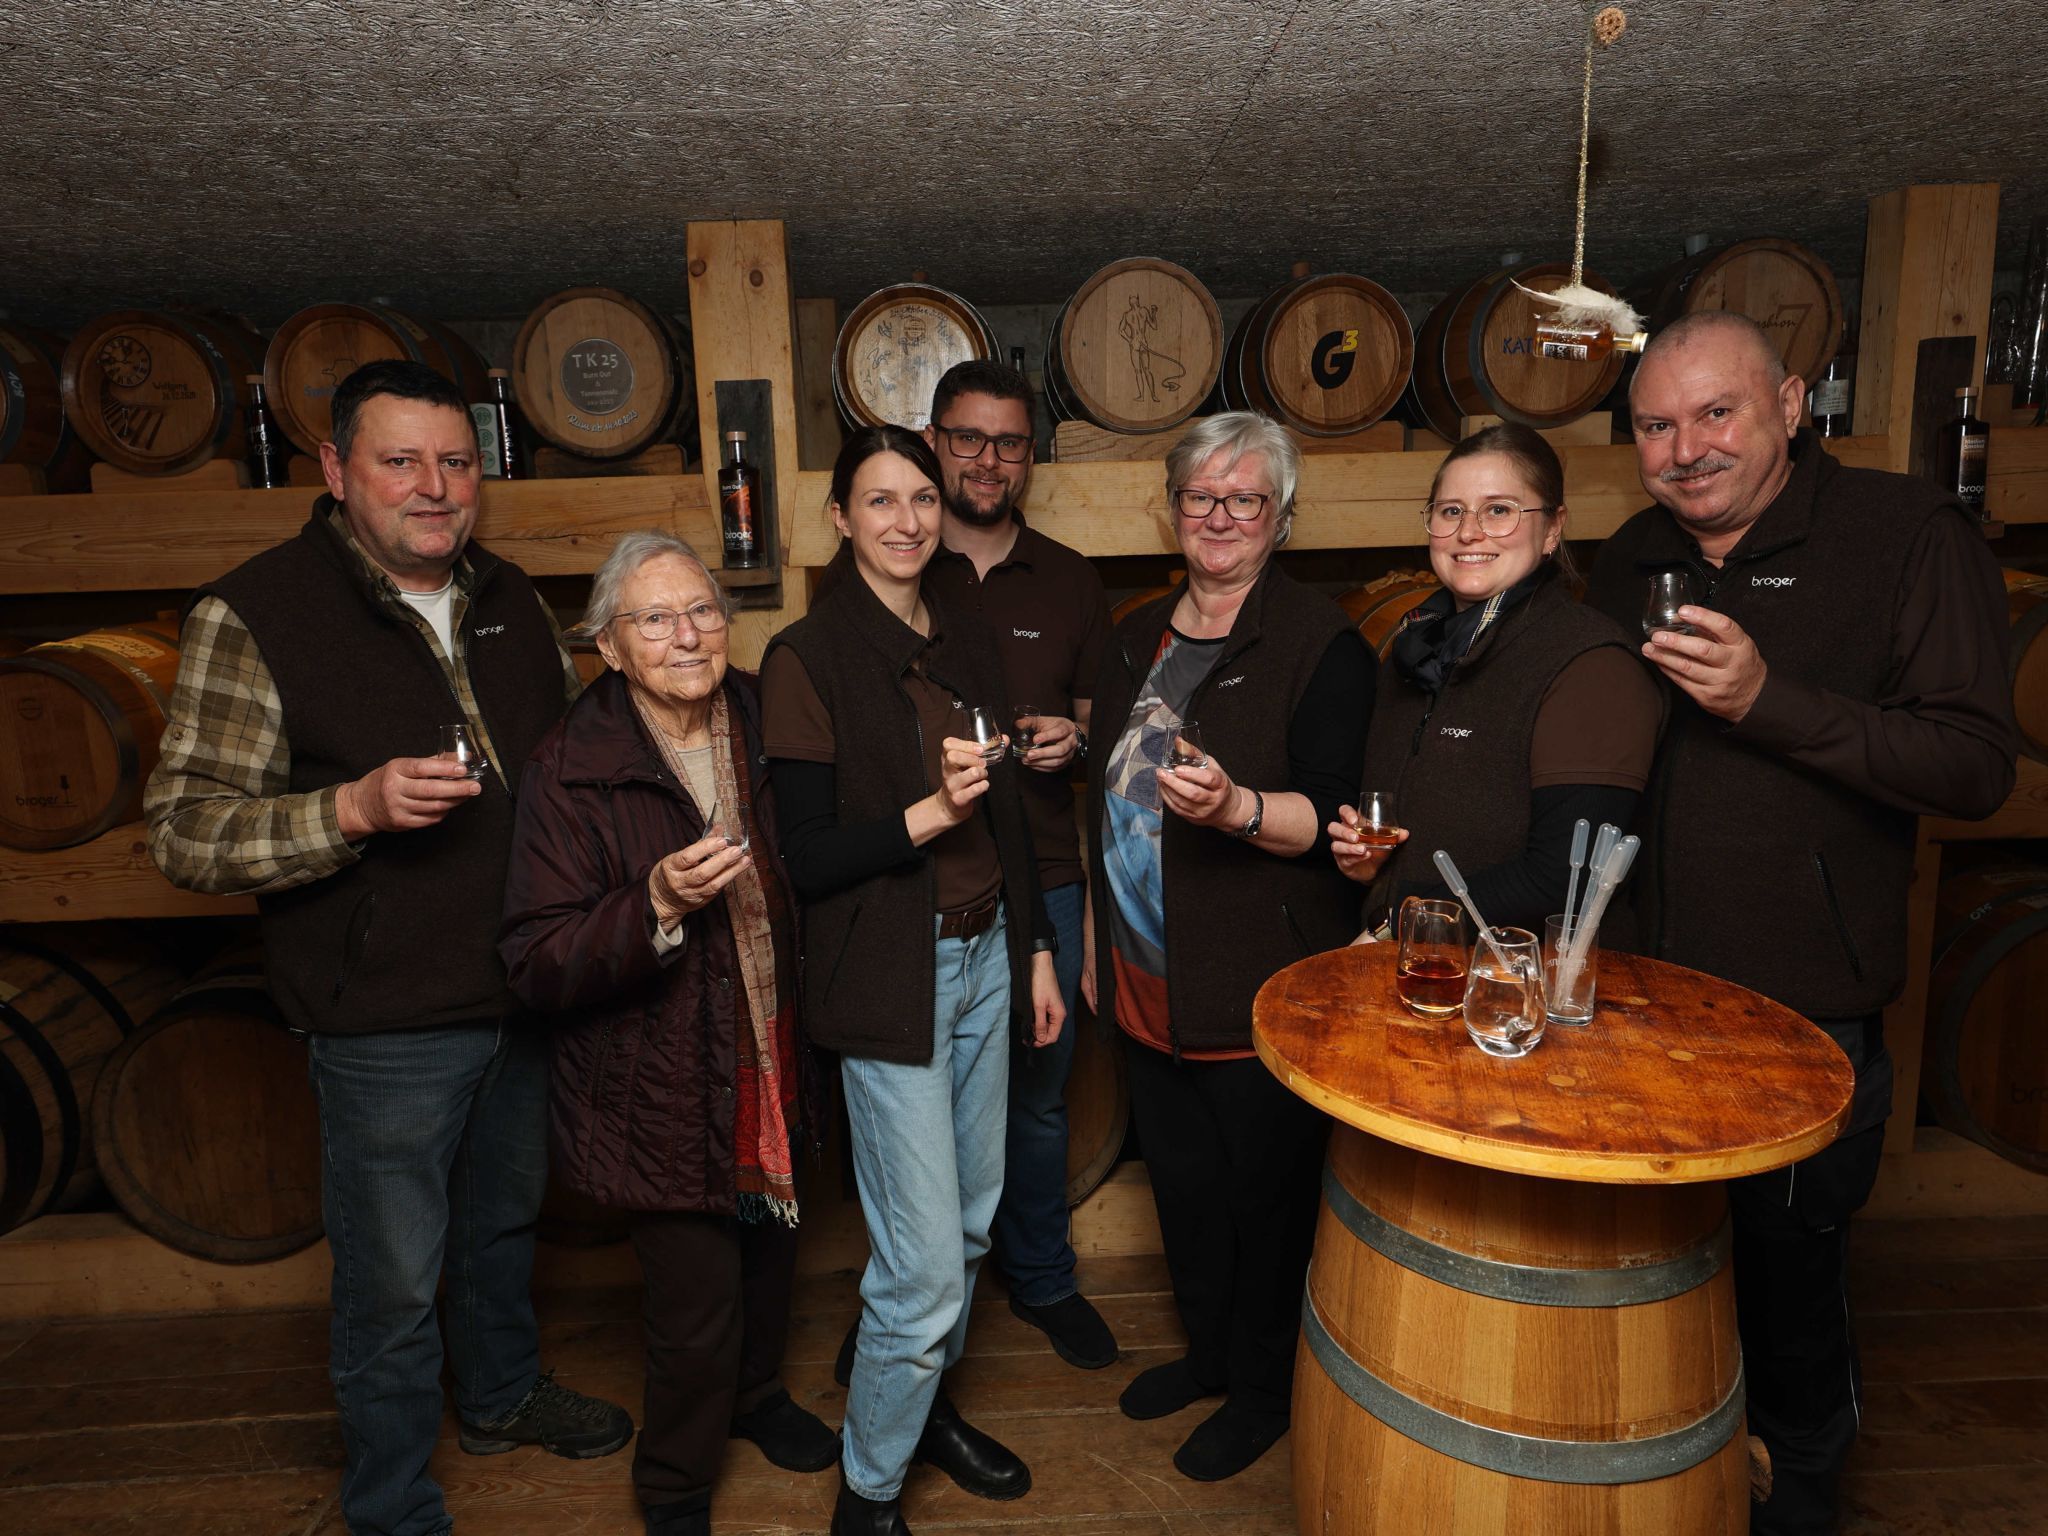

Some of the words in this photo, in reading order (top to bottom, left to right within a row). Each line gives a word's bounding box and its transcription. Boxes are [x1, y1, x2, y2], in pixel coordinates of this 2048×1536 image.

[601, 354, 619, 368] 25
[1751, 575, 1797, 588] broger
[474, 623, 505, 637] broger
[1013, 627, 1041, 639] broger
[1440, 726, 1473, 738] broger
[15, 793, 59, 808] broger
